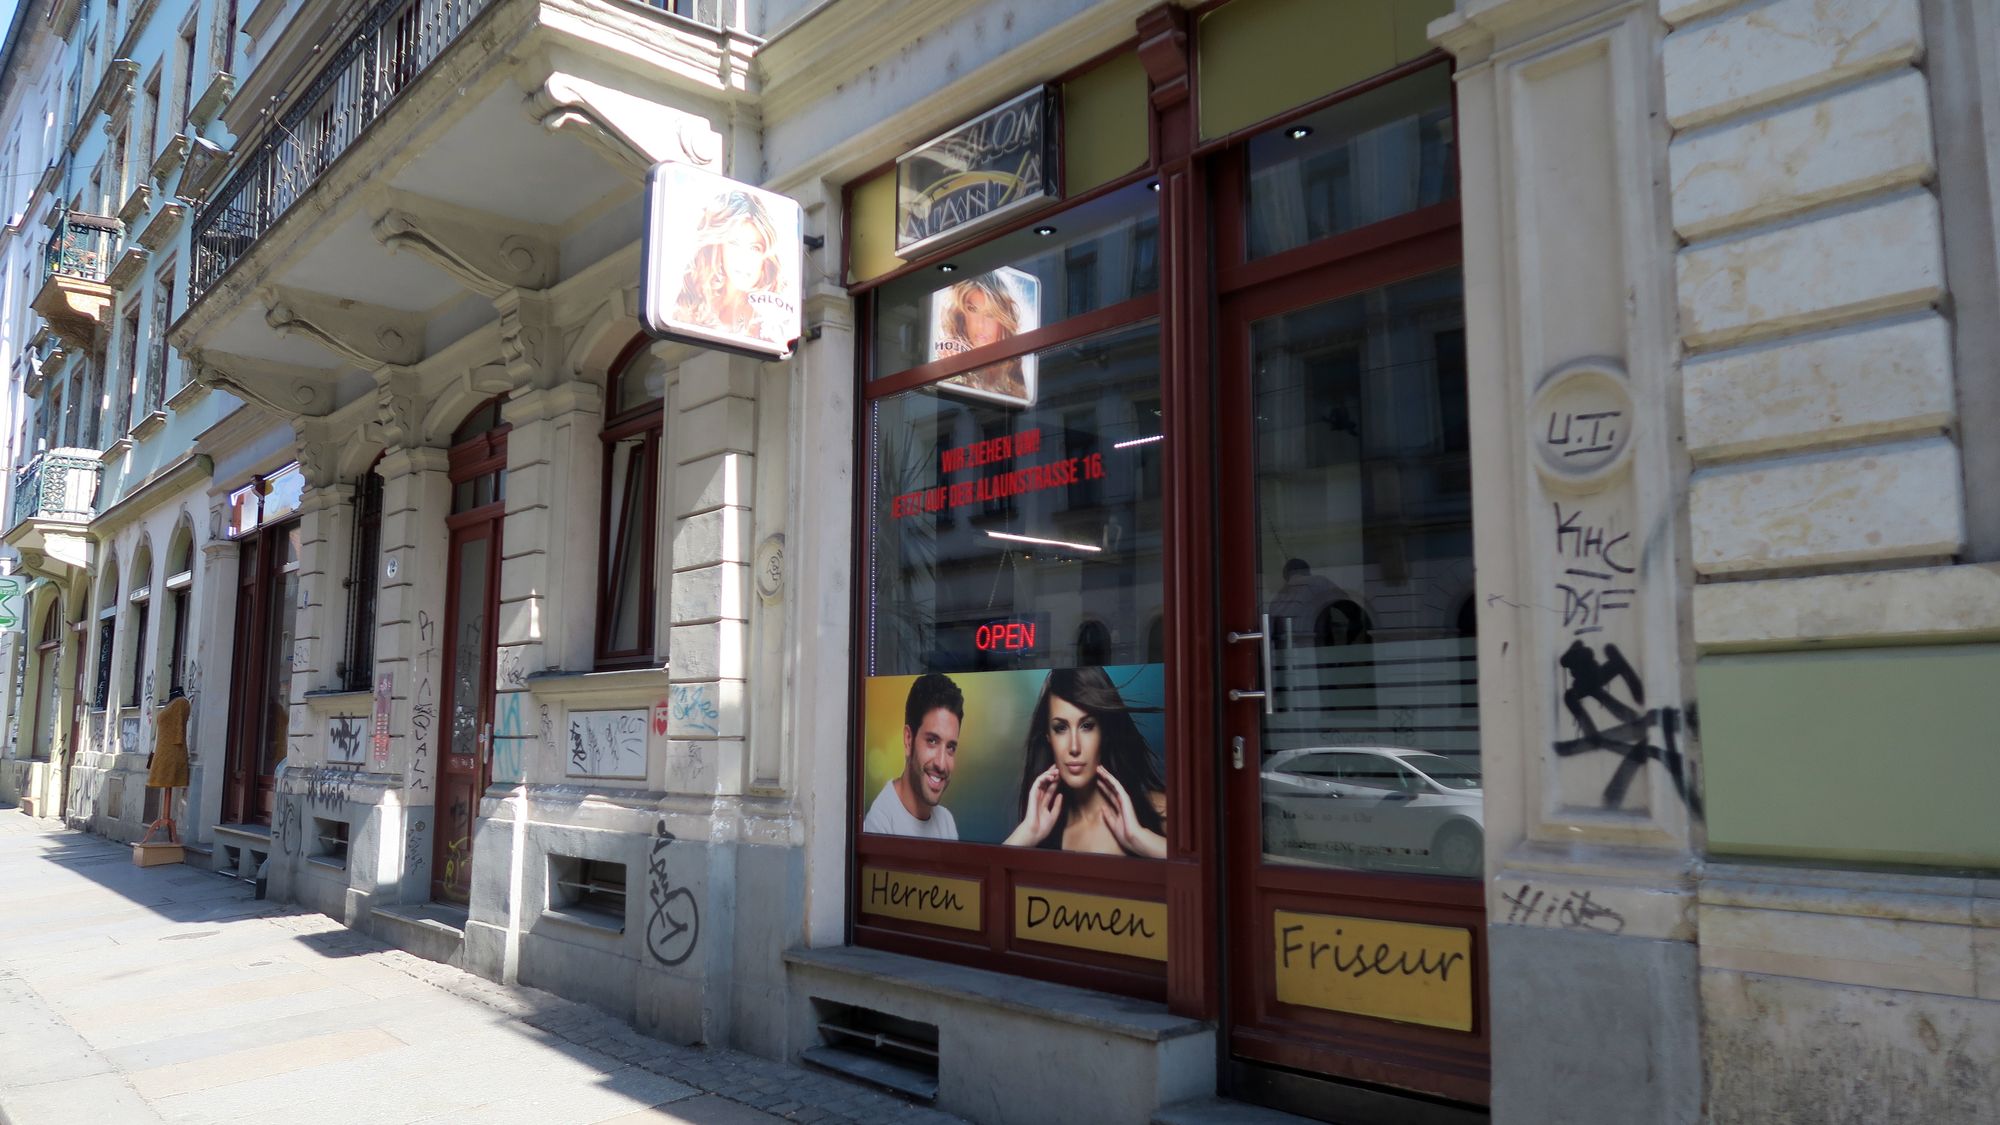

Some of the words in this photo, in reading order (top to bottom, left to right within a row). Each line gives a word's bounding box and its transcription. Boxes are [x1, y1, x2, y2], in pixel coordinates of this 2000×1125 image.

[749, 293, 795, 314] SALON
[941, 448, 966, 473] WIR
[966, 436, 1012, 469] ZIEHEN
[1014, 428, 1041, 457] UM!
[890, 492, 923, 519] JETZT
[924, 486, 949, 512] AUF
[950, 481, 975, 507] DER
[976, 458, 1079, 501] ALAUNSTRASSE
[976, 623, 1036, 650] OPEN
[871, 871, 964, 912] Herren
[1026, 895, 1155, 938] Damen
[1281, 924, 1465, 982] Friseur
